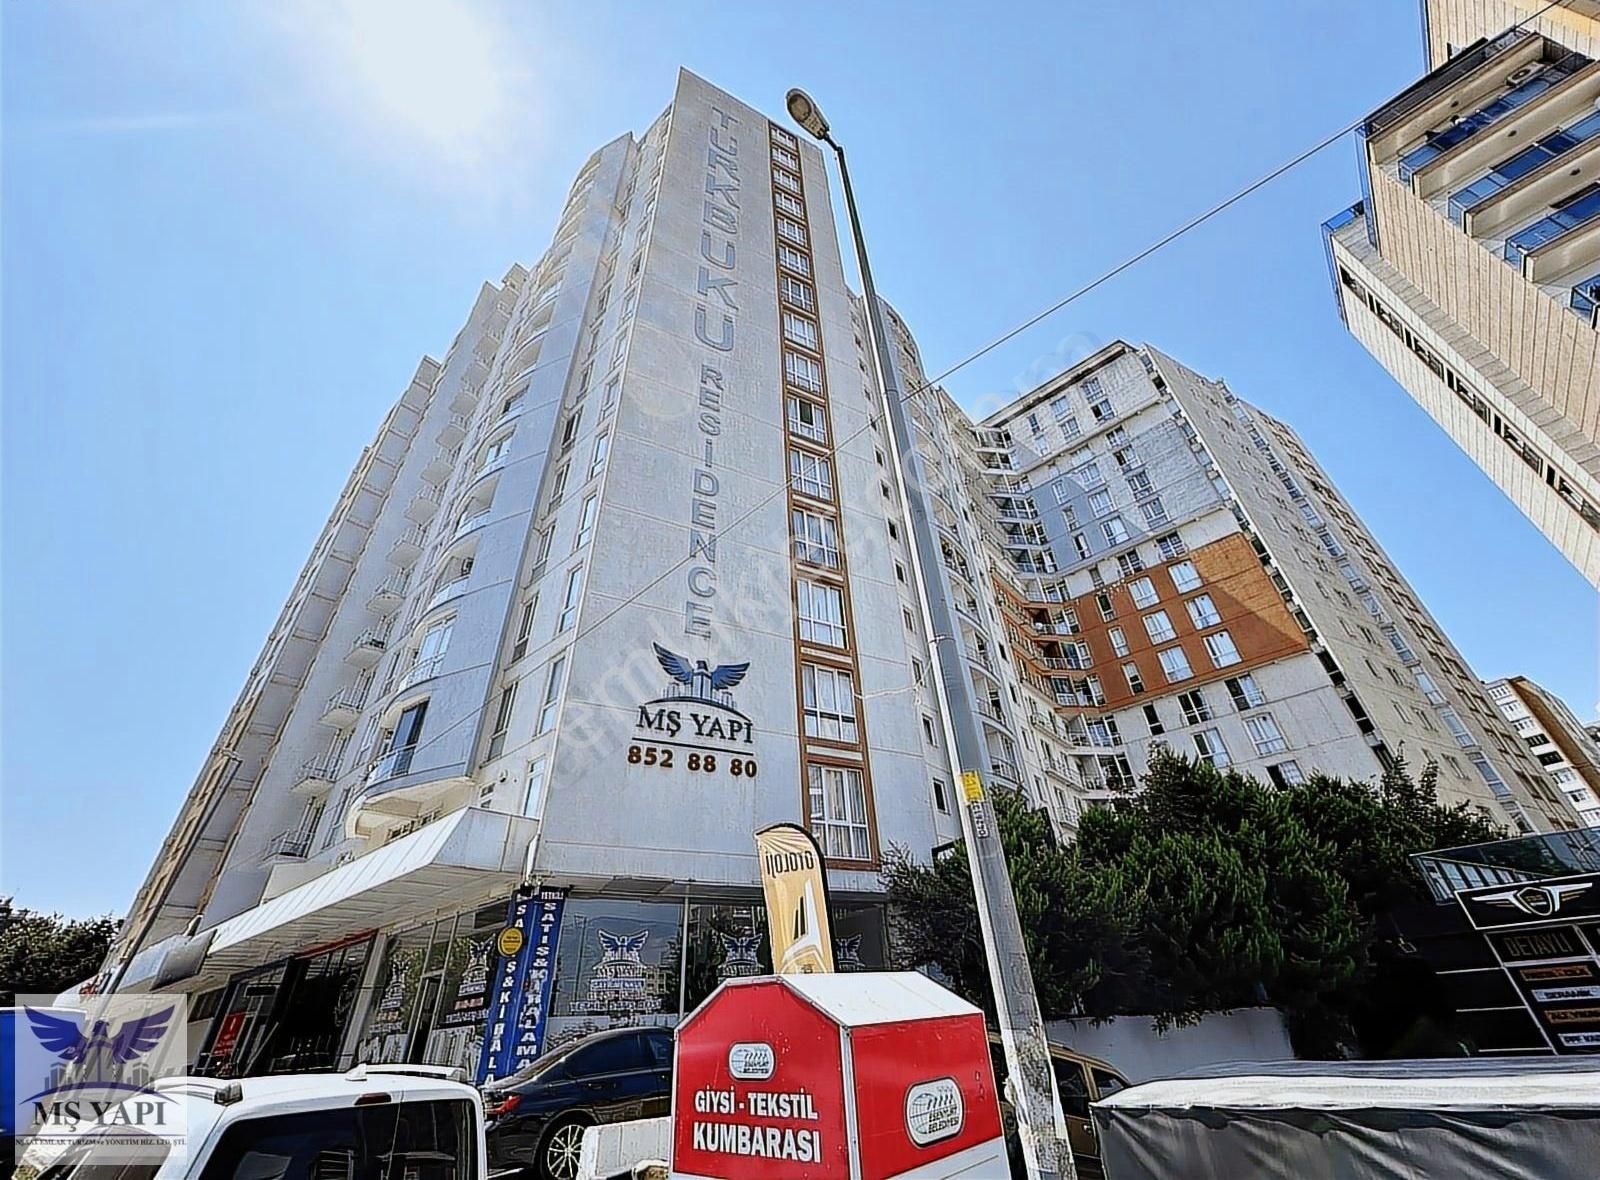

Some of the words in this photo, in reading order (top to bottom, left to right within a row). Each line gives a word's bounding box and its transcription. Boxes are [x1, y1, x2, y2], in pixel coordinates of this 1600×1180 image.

[636, 705, 682, 737] MŞ
[690, 713, 753, 743] YAPI
[627, 745, 673, 768] 852
[687, 753, 716, 772] 88
[730, 758, 757, 778] 80
[695, 1085, 735, 1114] GİYSİ
[747, 1088, 818, 1120] TEKSTİL
[693, 1121, 820, 1163] KUMBARASI
